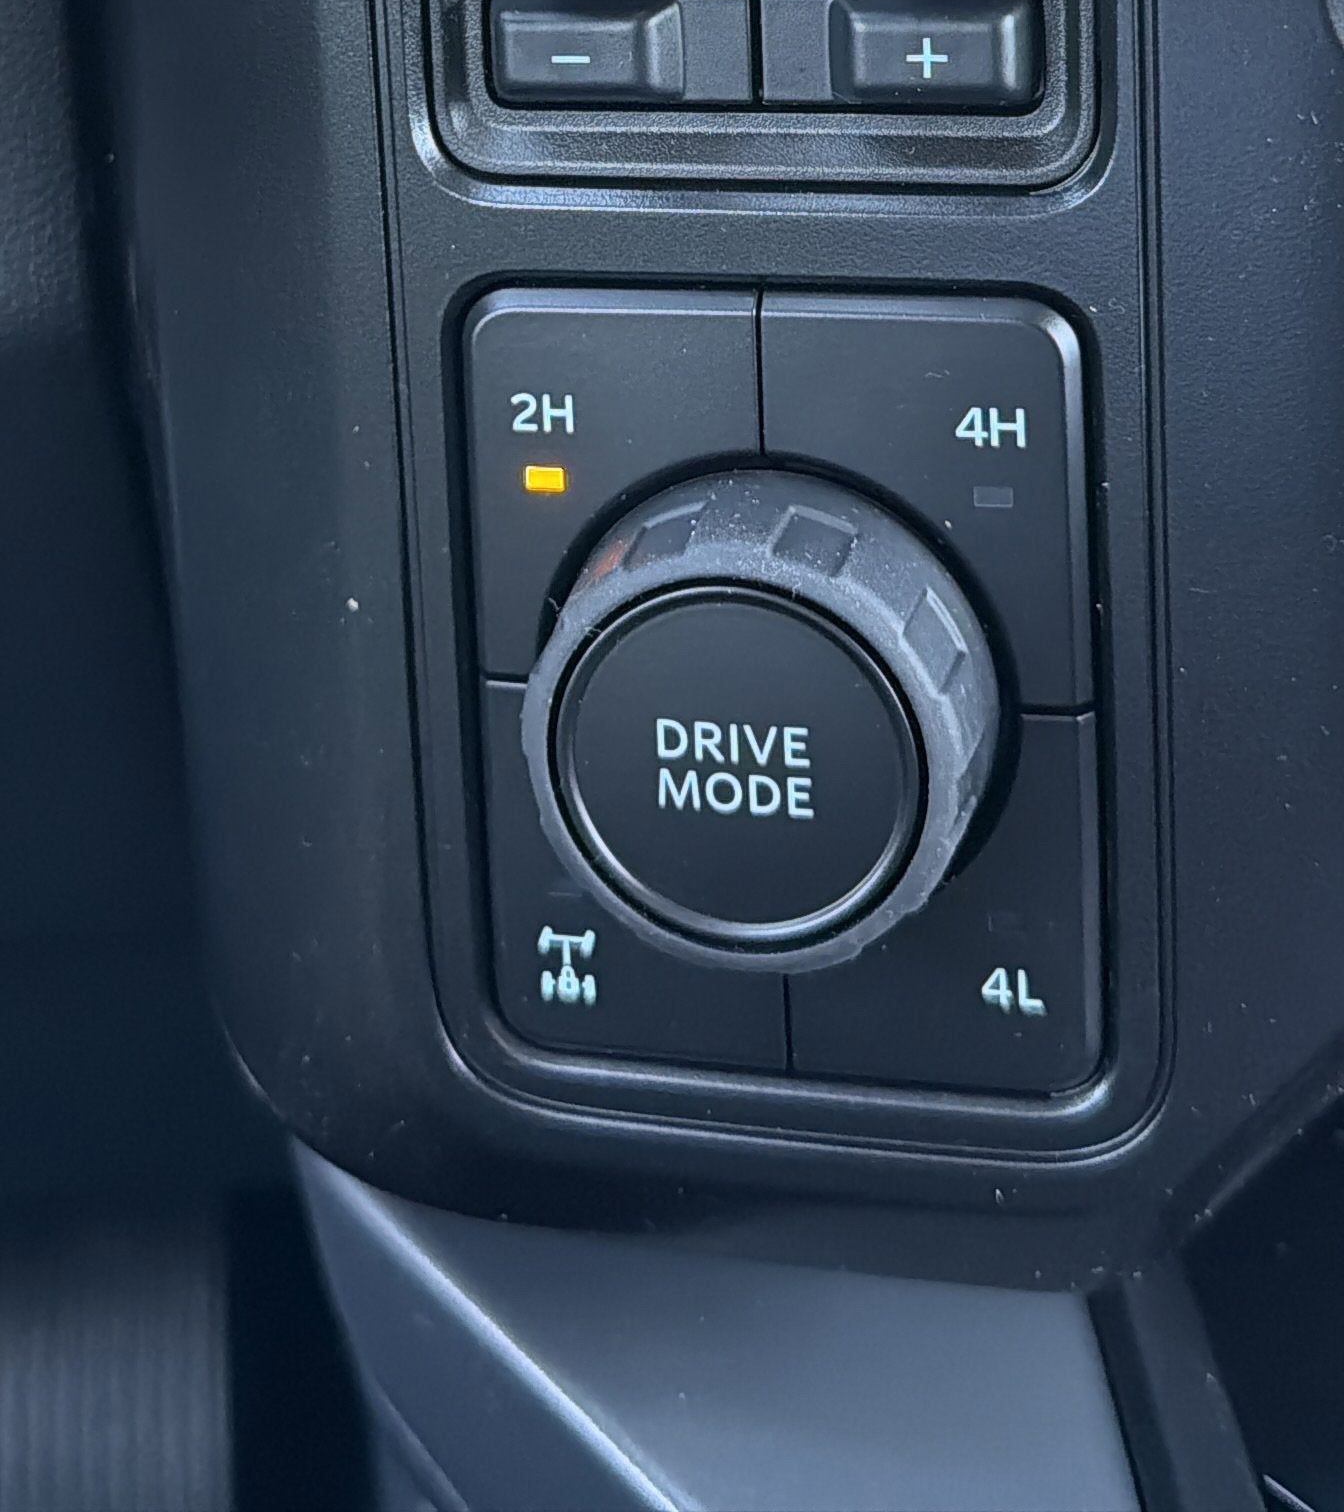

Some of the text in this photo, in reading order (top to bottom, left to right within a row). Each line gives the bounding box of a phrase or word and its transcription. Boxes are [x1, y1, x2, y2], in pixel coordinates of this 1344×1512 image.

[510, 393, 576, 435] 2H
[954, 407, 1028, 449] 4H
[654, 718, 812, 769] DRIVE
[656, 769, 816, 820] MODE
[980, 968, 1048, 1018] 4L
